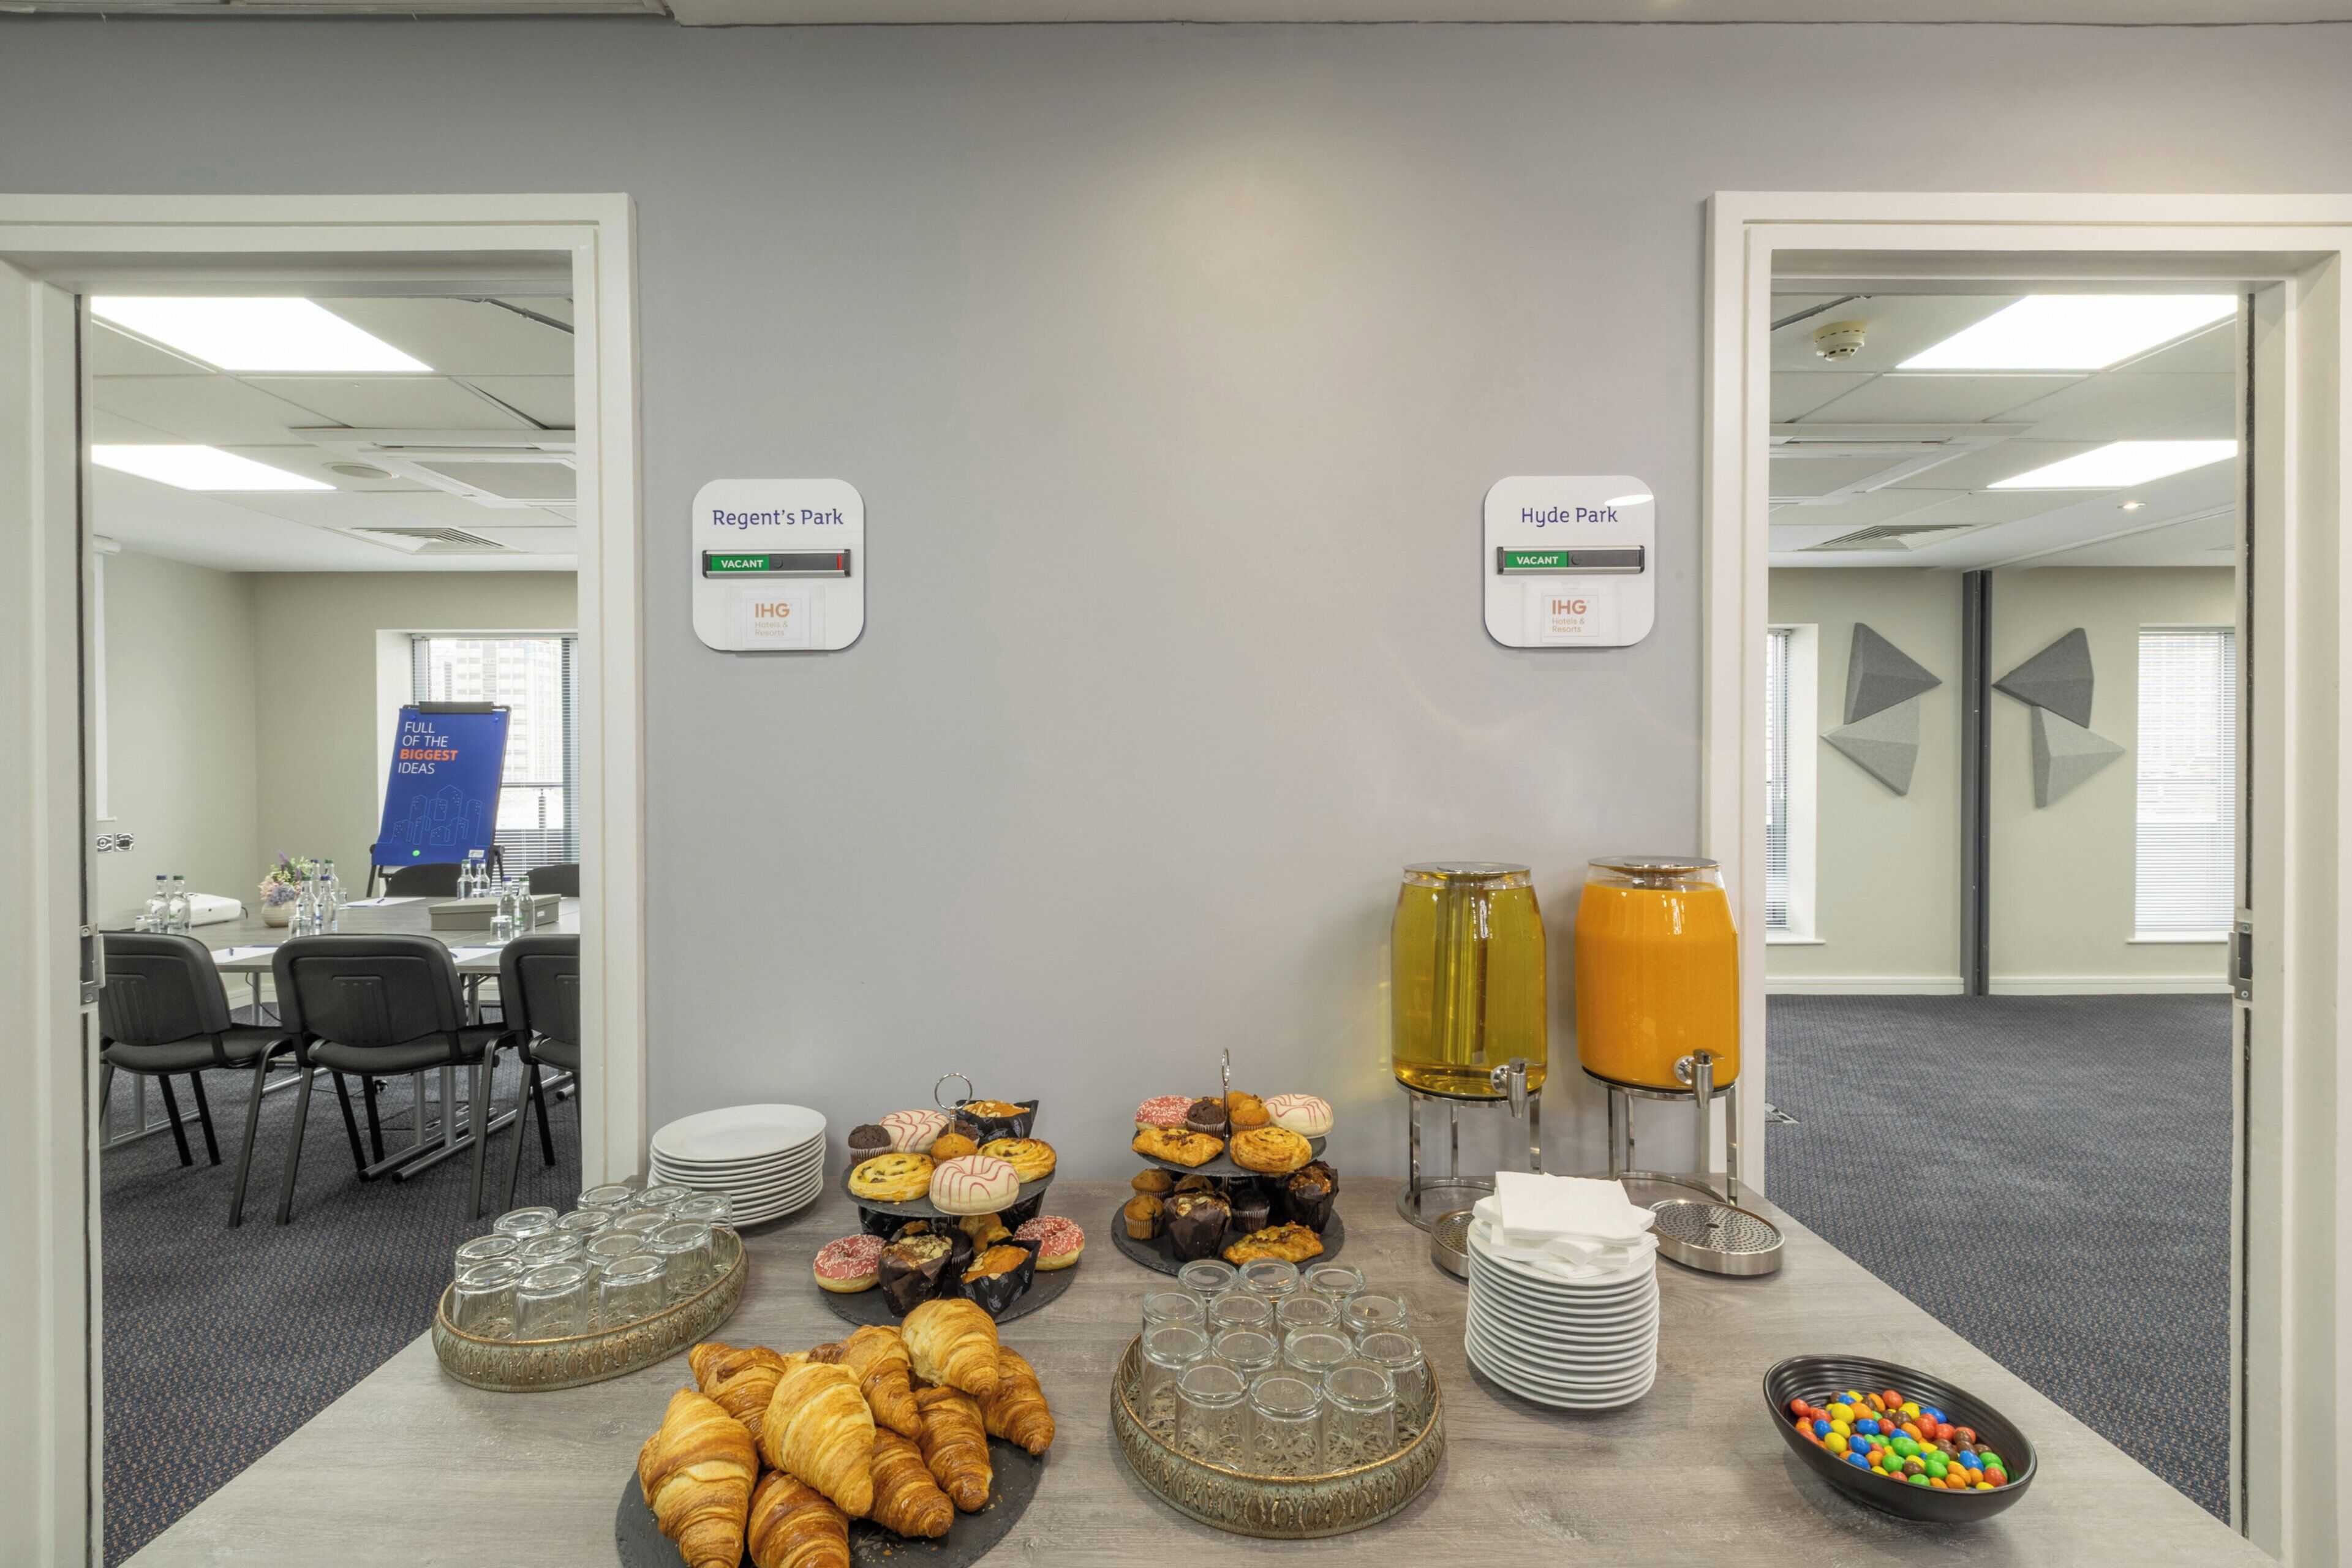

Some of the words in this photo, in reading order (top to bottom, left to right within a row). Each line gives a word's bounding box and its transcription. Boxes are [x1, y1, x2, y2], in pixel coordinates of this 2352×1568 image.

[712, 510, 795, 530] Regent's
[801, 508, 844, 525] Park
[1521, 507, 1570, 527] Hyde
[1575, 507, 1618, 522] Park
[721, 559, 764, 568] VACANT
[1517, 556, 1559, 565] VACANT
[755, 603, 790, 618] IHG
[1552, 600, 1587, 615] IHG
[404, 722, 435, 734] FULL
[402, 735, 420, 747] OF
[424, 736, 449, 747] THE
[399, 748, 458, 761] BIGGEST
[398, 763, 435, 775] IDEAS
